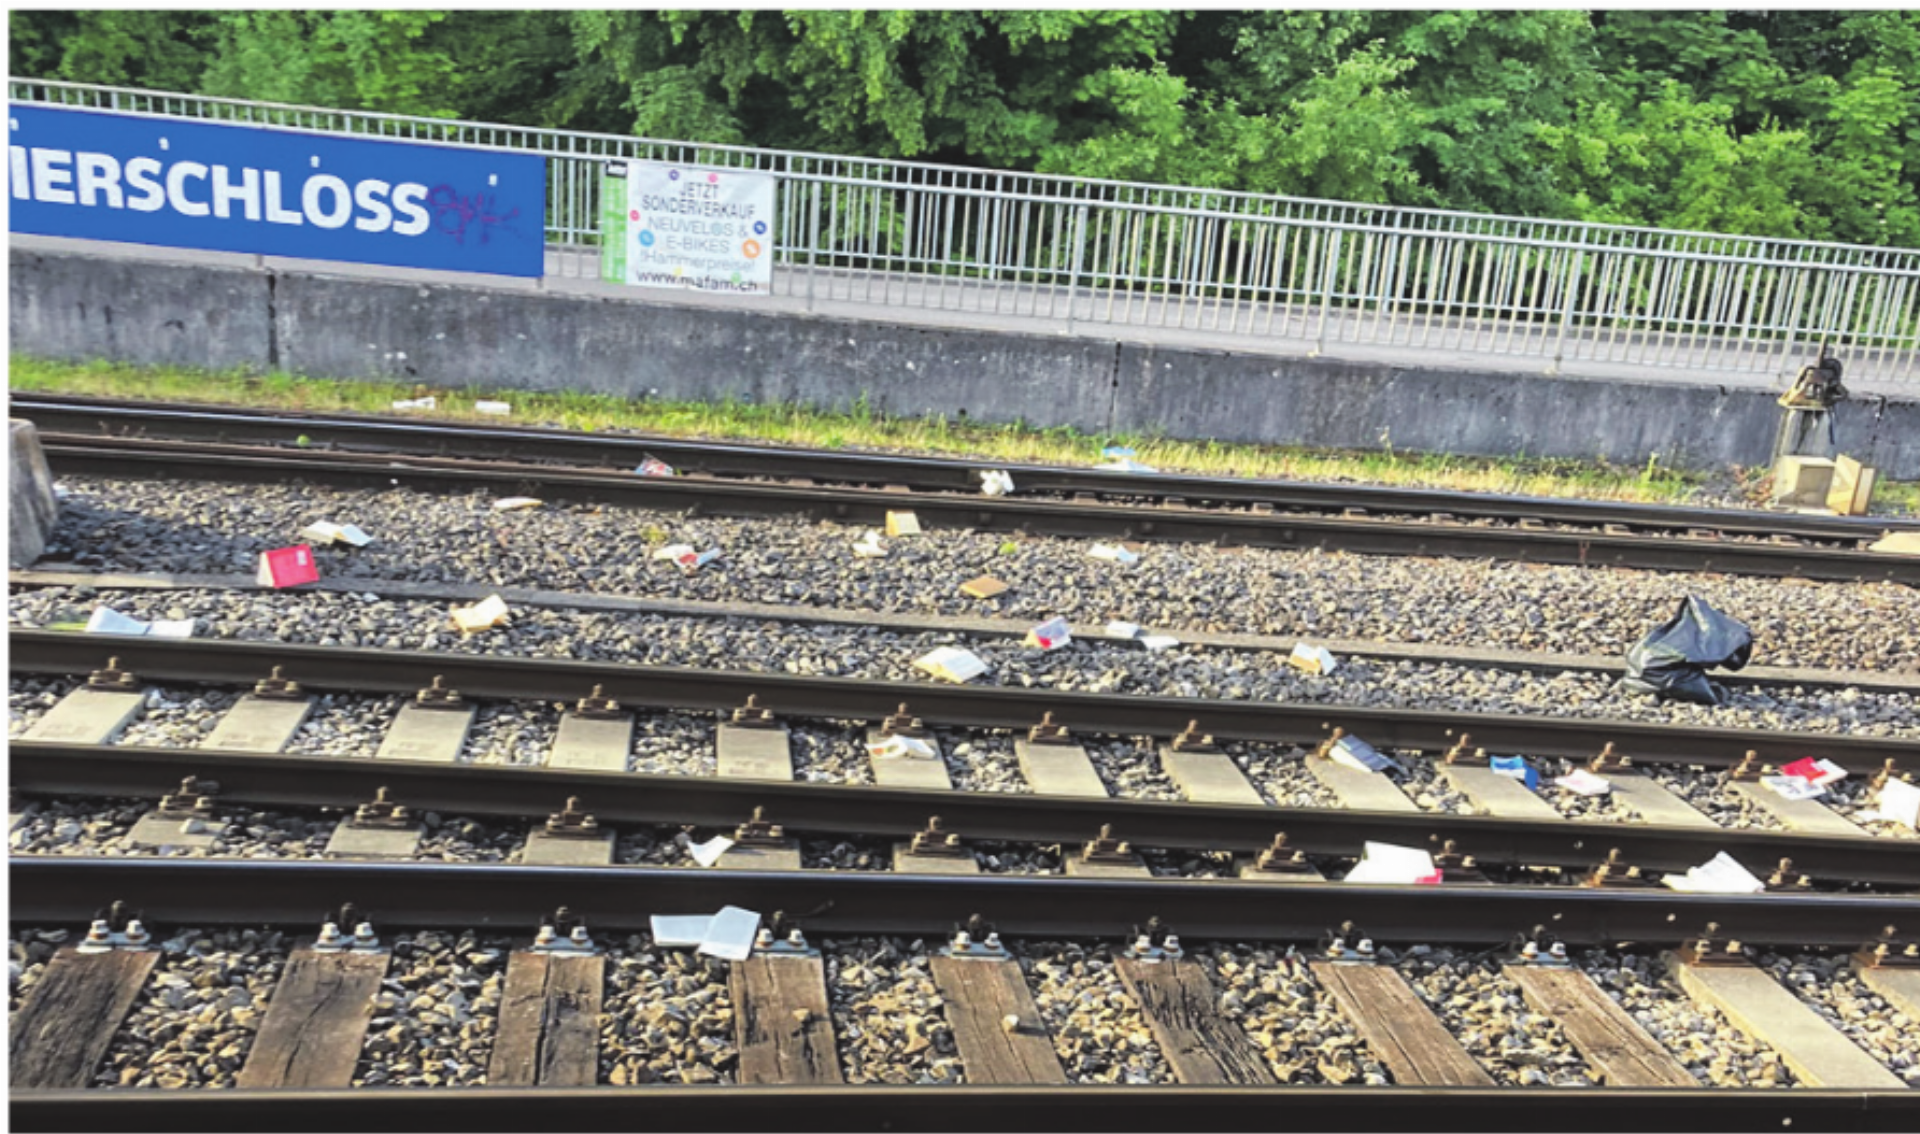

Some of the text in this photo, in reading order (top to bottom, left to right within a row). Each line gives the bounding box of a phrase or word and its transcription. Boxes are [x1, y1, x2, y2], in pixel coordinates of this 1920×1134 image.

[679, 182, 719, 198] JETZT
[642, 195, 755, 220] SONDERVERKAUF
[648, 216, 734, 237] NEUVELOS
[666, 235, 730, 253] E-BIKES
[637, 271, 757, 291] www.mafam.ch
